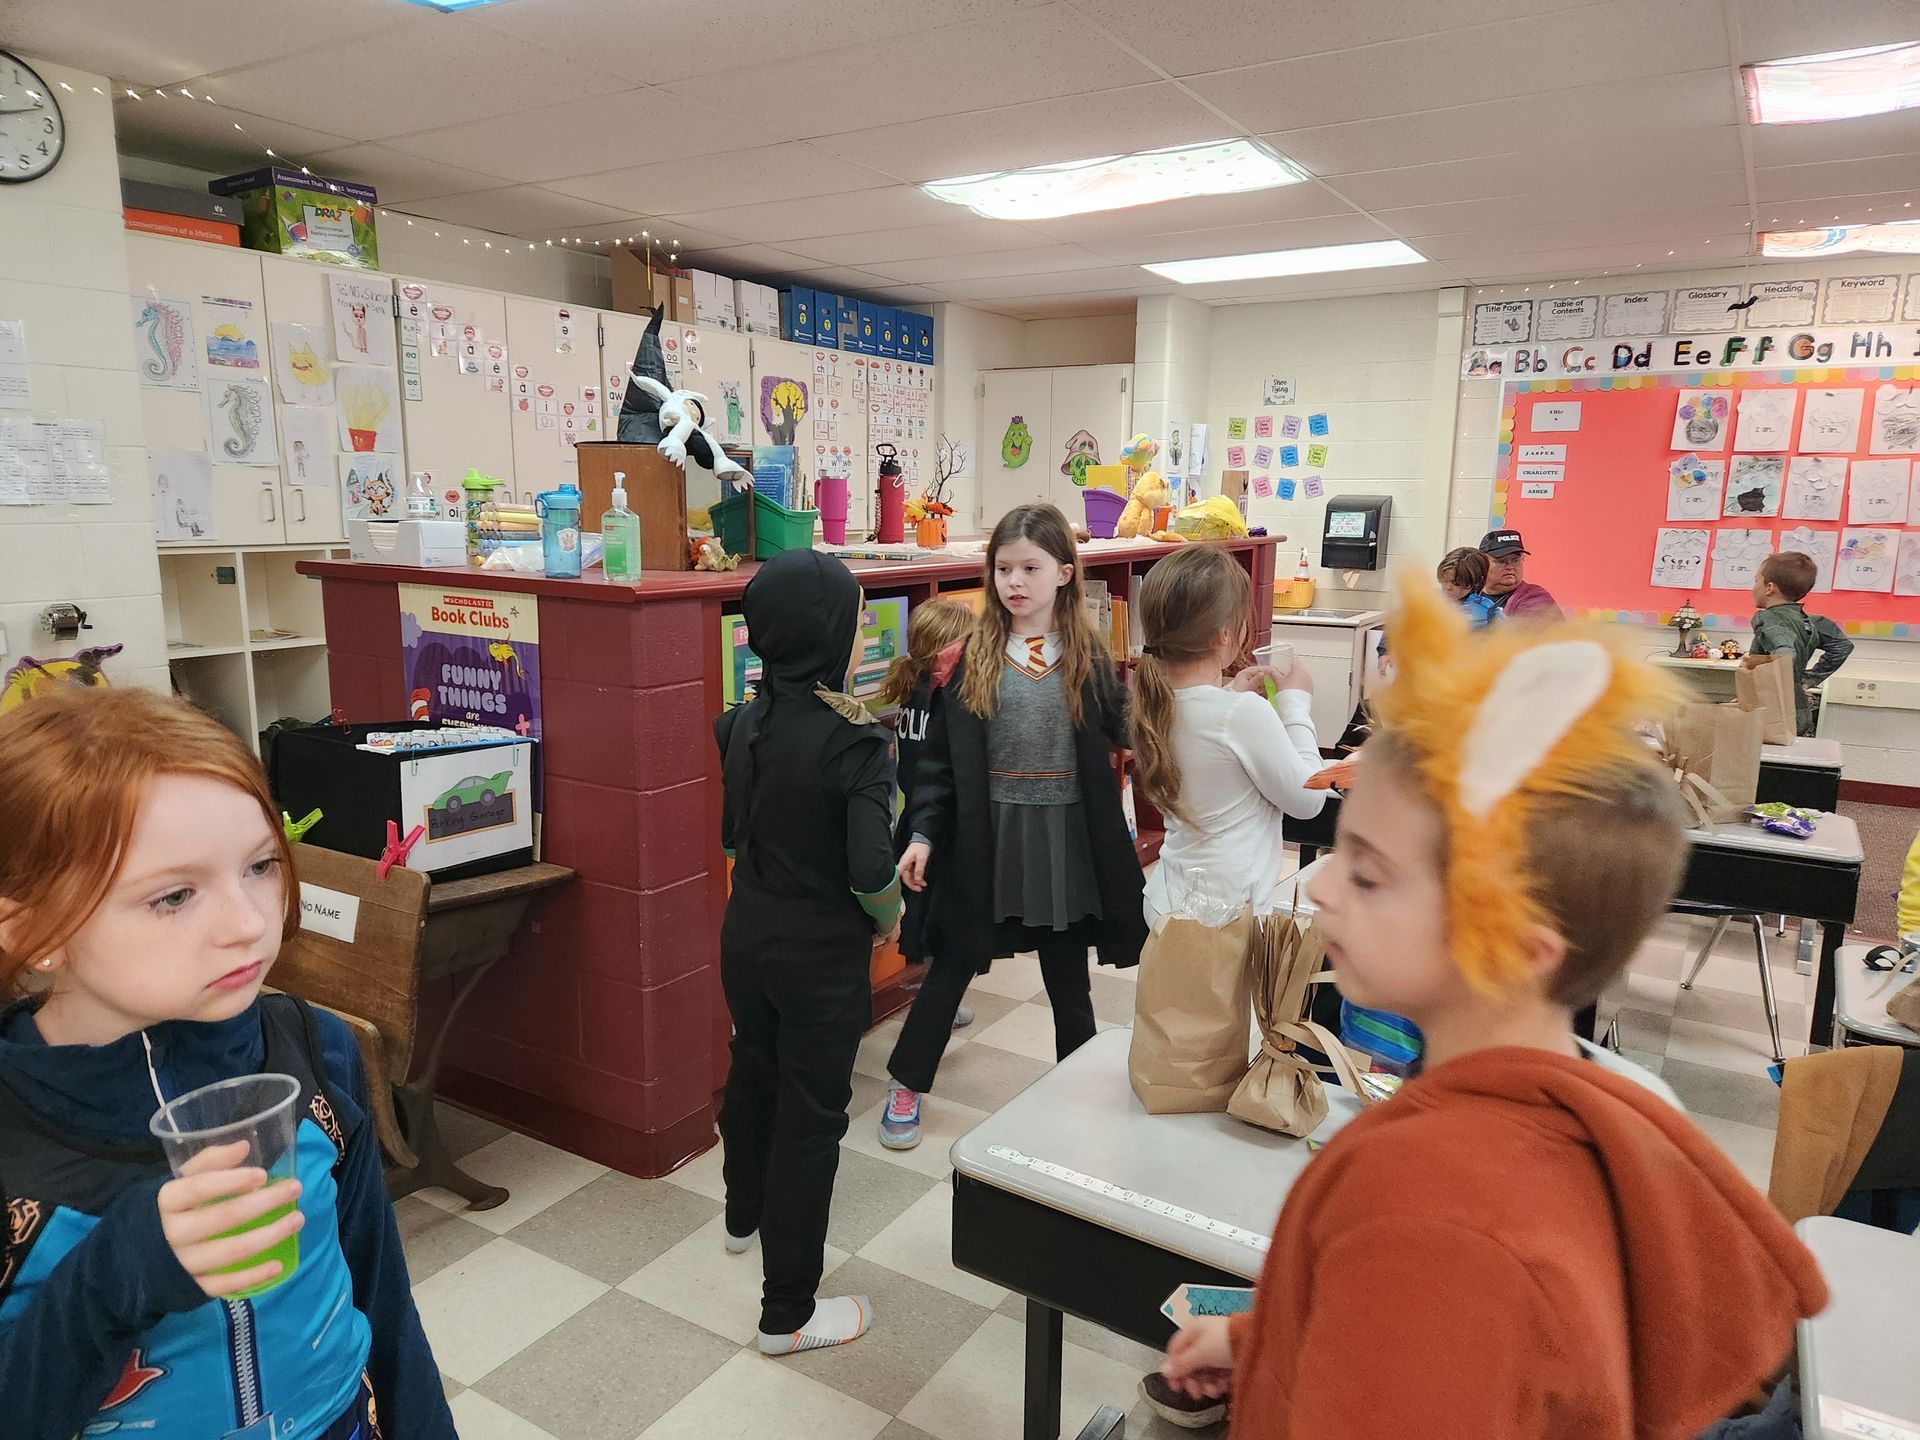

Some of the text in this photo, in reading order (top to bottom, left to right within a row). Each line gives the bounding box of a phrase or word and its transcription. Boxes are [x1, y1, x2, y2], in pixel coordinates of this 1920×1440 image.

[12, 68, 22, 86] 1
[43, 116, 54, 134] 3
[36, 140, 49, 156] 4
[18, 154, 30, 171] 5
[276, 173, 311, 186] Assessment
[311, 179, 324, 189] That
[346, 186, 375, 198] Instruction
[179, 227, 188, 236] of
[1841, 278, 1885, 289] Keyword
[1764, 284, 1803, 295] Heading
[1624, 296, 1649, 304] Index
[1688, 291, 1728, 300] Glossary
[1485, 304, 1523, 314] Title Page
[1553, 299, 1584, 309] Table of
[1551, 307, 1585, 315] Contents
[686, 344, 697, 354] ue
[1515, 349, 1548, 374] Bb
[1562, 346, 1596, 373] Cc
[1611, 342, 1653, 370] Dd
[1673, 340, 1712, 366] Ee
[1720, 336, 1775, 366] Ff
[1788, 333, 1834, 364] Gg
[1850, 331, 1893, 358] Hh
[405, 351, 417, 359] ea
[666, 353, 679, 362] oo
[816, 364, 825, 374] ch
[873, 372, 878, 381] b
[897, 375, 902, 384] d
[908, 377, 913, 386] k
[1271, 386, 1289, 394] Tying
[609, 391, 623, 401] aw
[449, 506, 459, 518] oi
[450, 597, 493, 608] SCHOLASTIC
[431, 607, 510, 629] Book Clubs
[441, 663, 501, 691] FUNNY
[438, 685, 507, 715] THINGS
[465, 710, 481, 722] are
[471, 808, 504, 822] Garage
[314, 903, 341, 920] NAME
